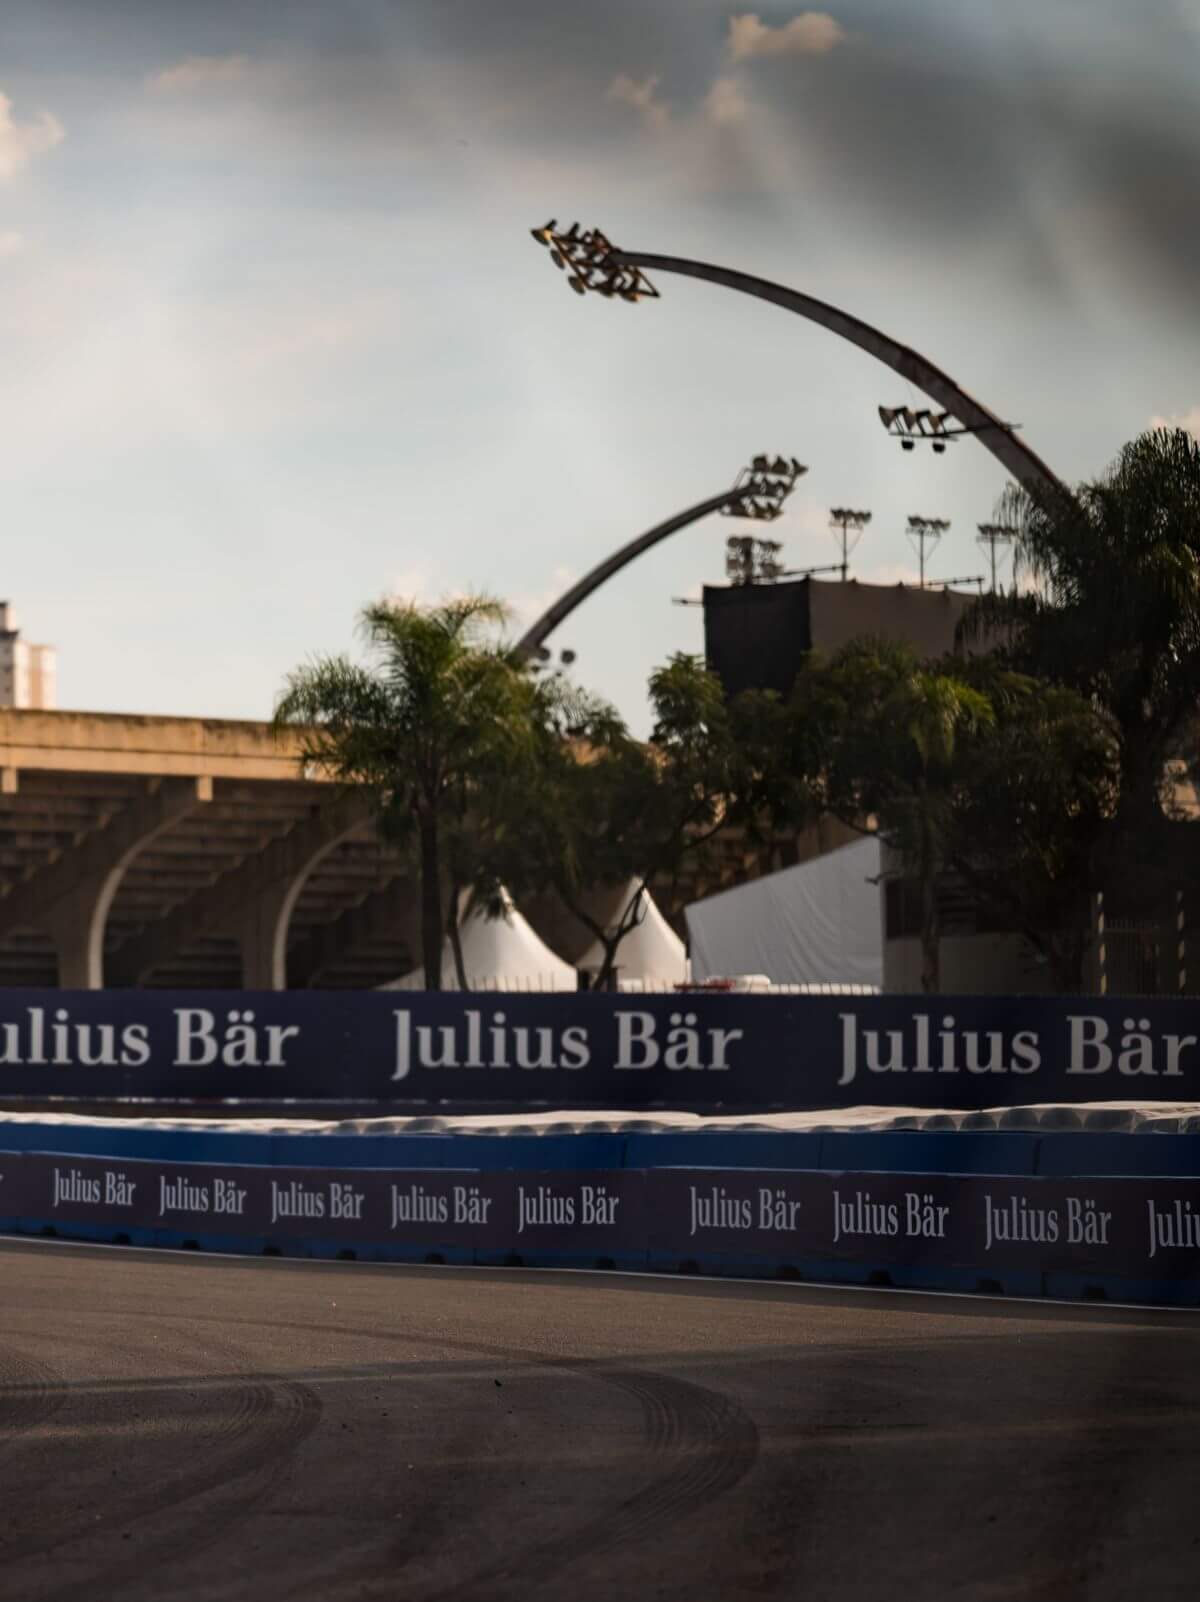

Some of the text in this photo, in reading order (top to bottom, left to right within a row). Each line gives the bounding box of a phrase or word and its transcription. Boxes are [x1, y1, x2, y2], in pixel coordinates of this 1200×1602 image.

[173, 1008, 300, 1067] Bär
[391, 1009, 743, 1081] Julius Bär
[837, 1013, 1198, 1086] Julius Bär
[53, 1167, 137, 1208] Julius Bär
[159, 1175, 247, 1216] Julius Bär
[271, 1180, 365, 1224] Julius Bär
[391, 1184, 492, 1229] Julius Bär
[517, 1186, 620, 1233] Julius Bär
[690, 1186, 801, 1236] Julius Bär
[832, 1190, 950, 1243] Julius Bär
[984, 1195, 1112, 1251] Julius Bär
